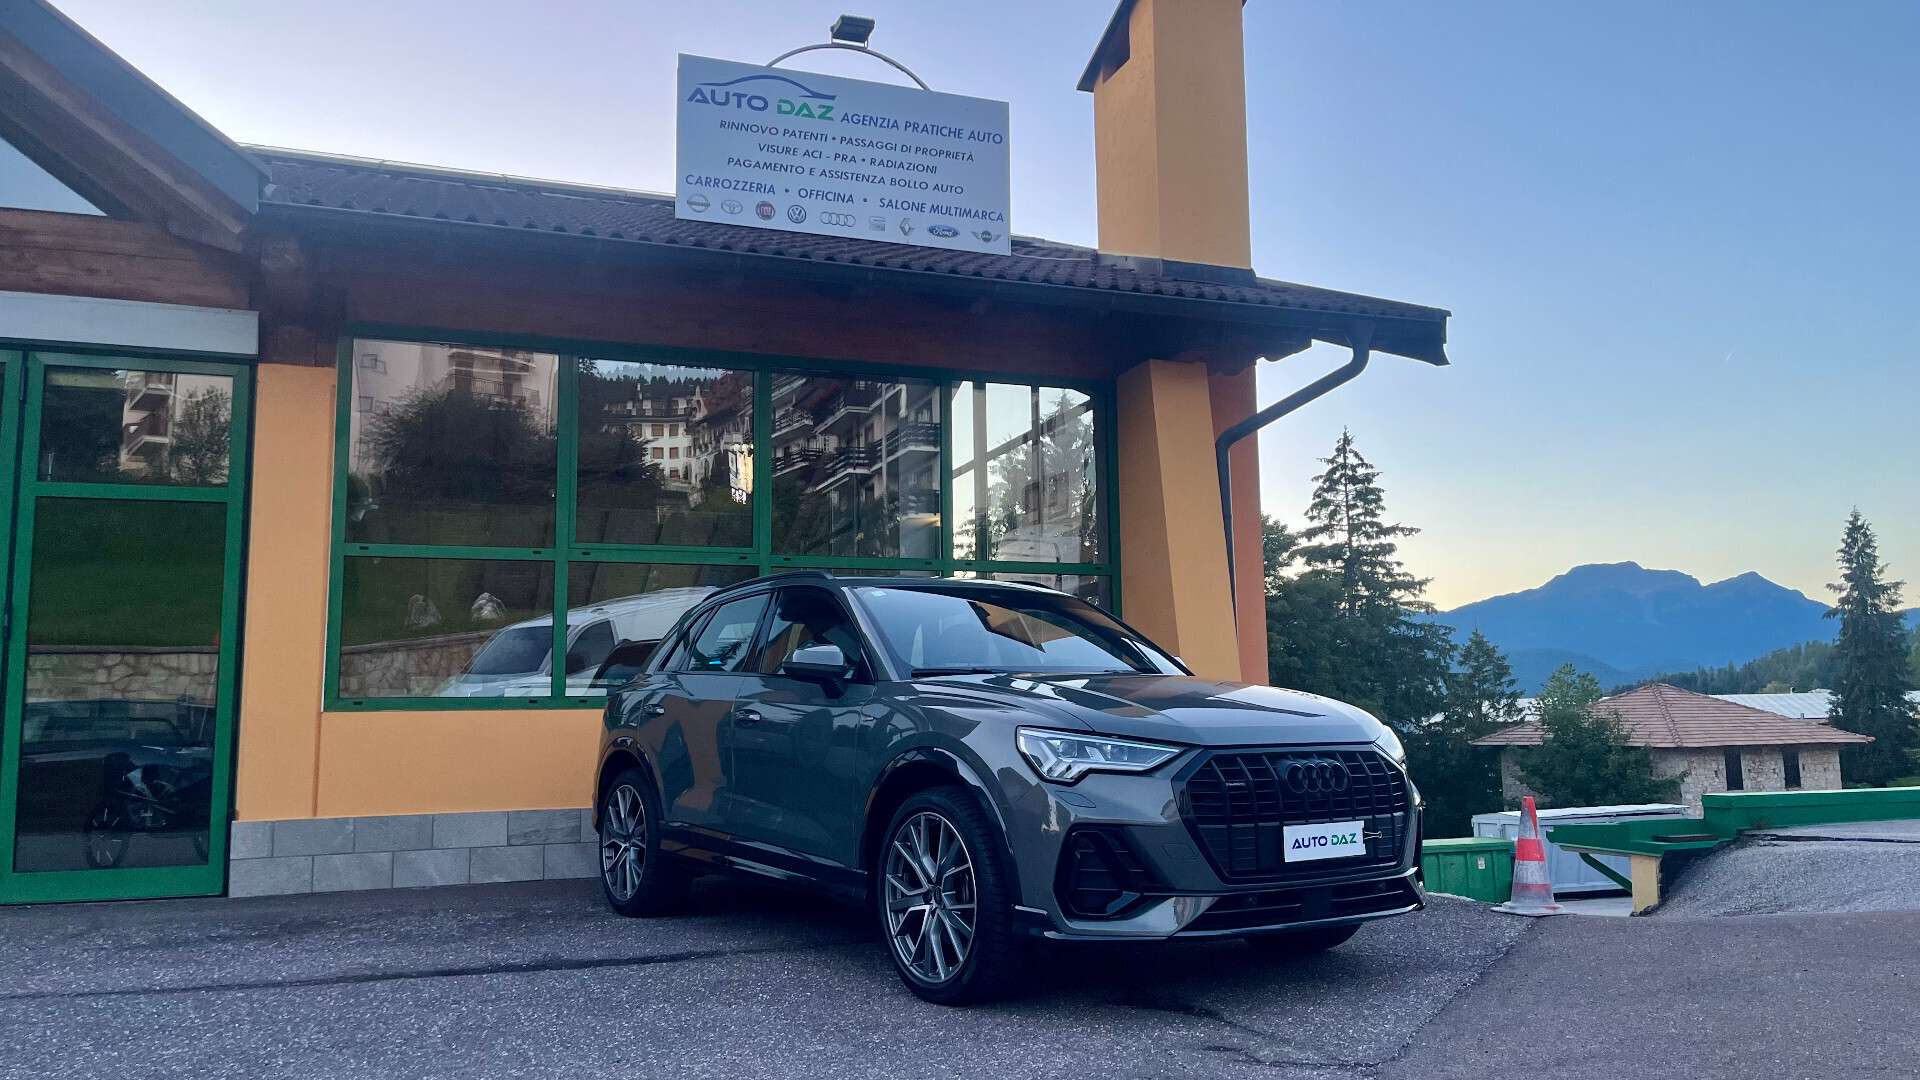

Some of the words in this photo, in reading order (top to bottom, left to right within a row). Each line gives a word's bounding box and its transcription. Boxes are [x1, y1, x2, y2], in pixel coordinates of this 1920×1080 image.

[688, 87, 768, 111] AUTO
[777, 99, 834, 121] DAZ
[720, 120, 779, 136] RINNOVO
[783, 128, 828, 142] PATENTI
[840, 136, 897, 152] PASSAGGI
[900, 144, 912, 153] DI
[841, 112, 899, 131] AGENZIA
[904, 120, 964, 140] PRATICHE
[967, 130, 1003, 145] AUTO
[758, 143, 799, 156] VISURE
[803, 149, 822, 159] ACI
[834, 152, 857, 164] PRA
[870, 157, 937, 174] RADIAZIONI
[727, 157, 805, 175] PAGAMENTO
[809, 167, 816, 176] E
[819, 168, 886, 185] ASSISTENZA
[889, 177, 929, 190] BOLLO
[932, 183, 964, 195] AUTO
[685, 174, 776, 195] CARROZZERIA
[798, 187, 854, 204] OFFICINA
[879, 197, 927, 213] SALONE
[929, 203, 1004, 223] MULTIMARCA
[1292, 835, 1328, 850] AUTO
[1331, 832, 1357, 846] DAZ
